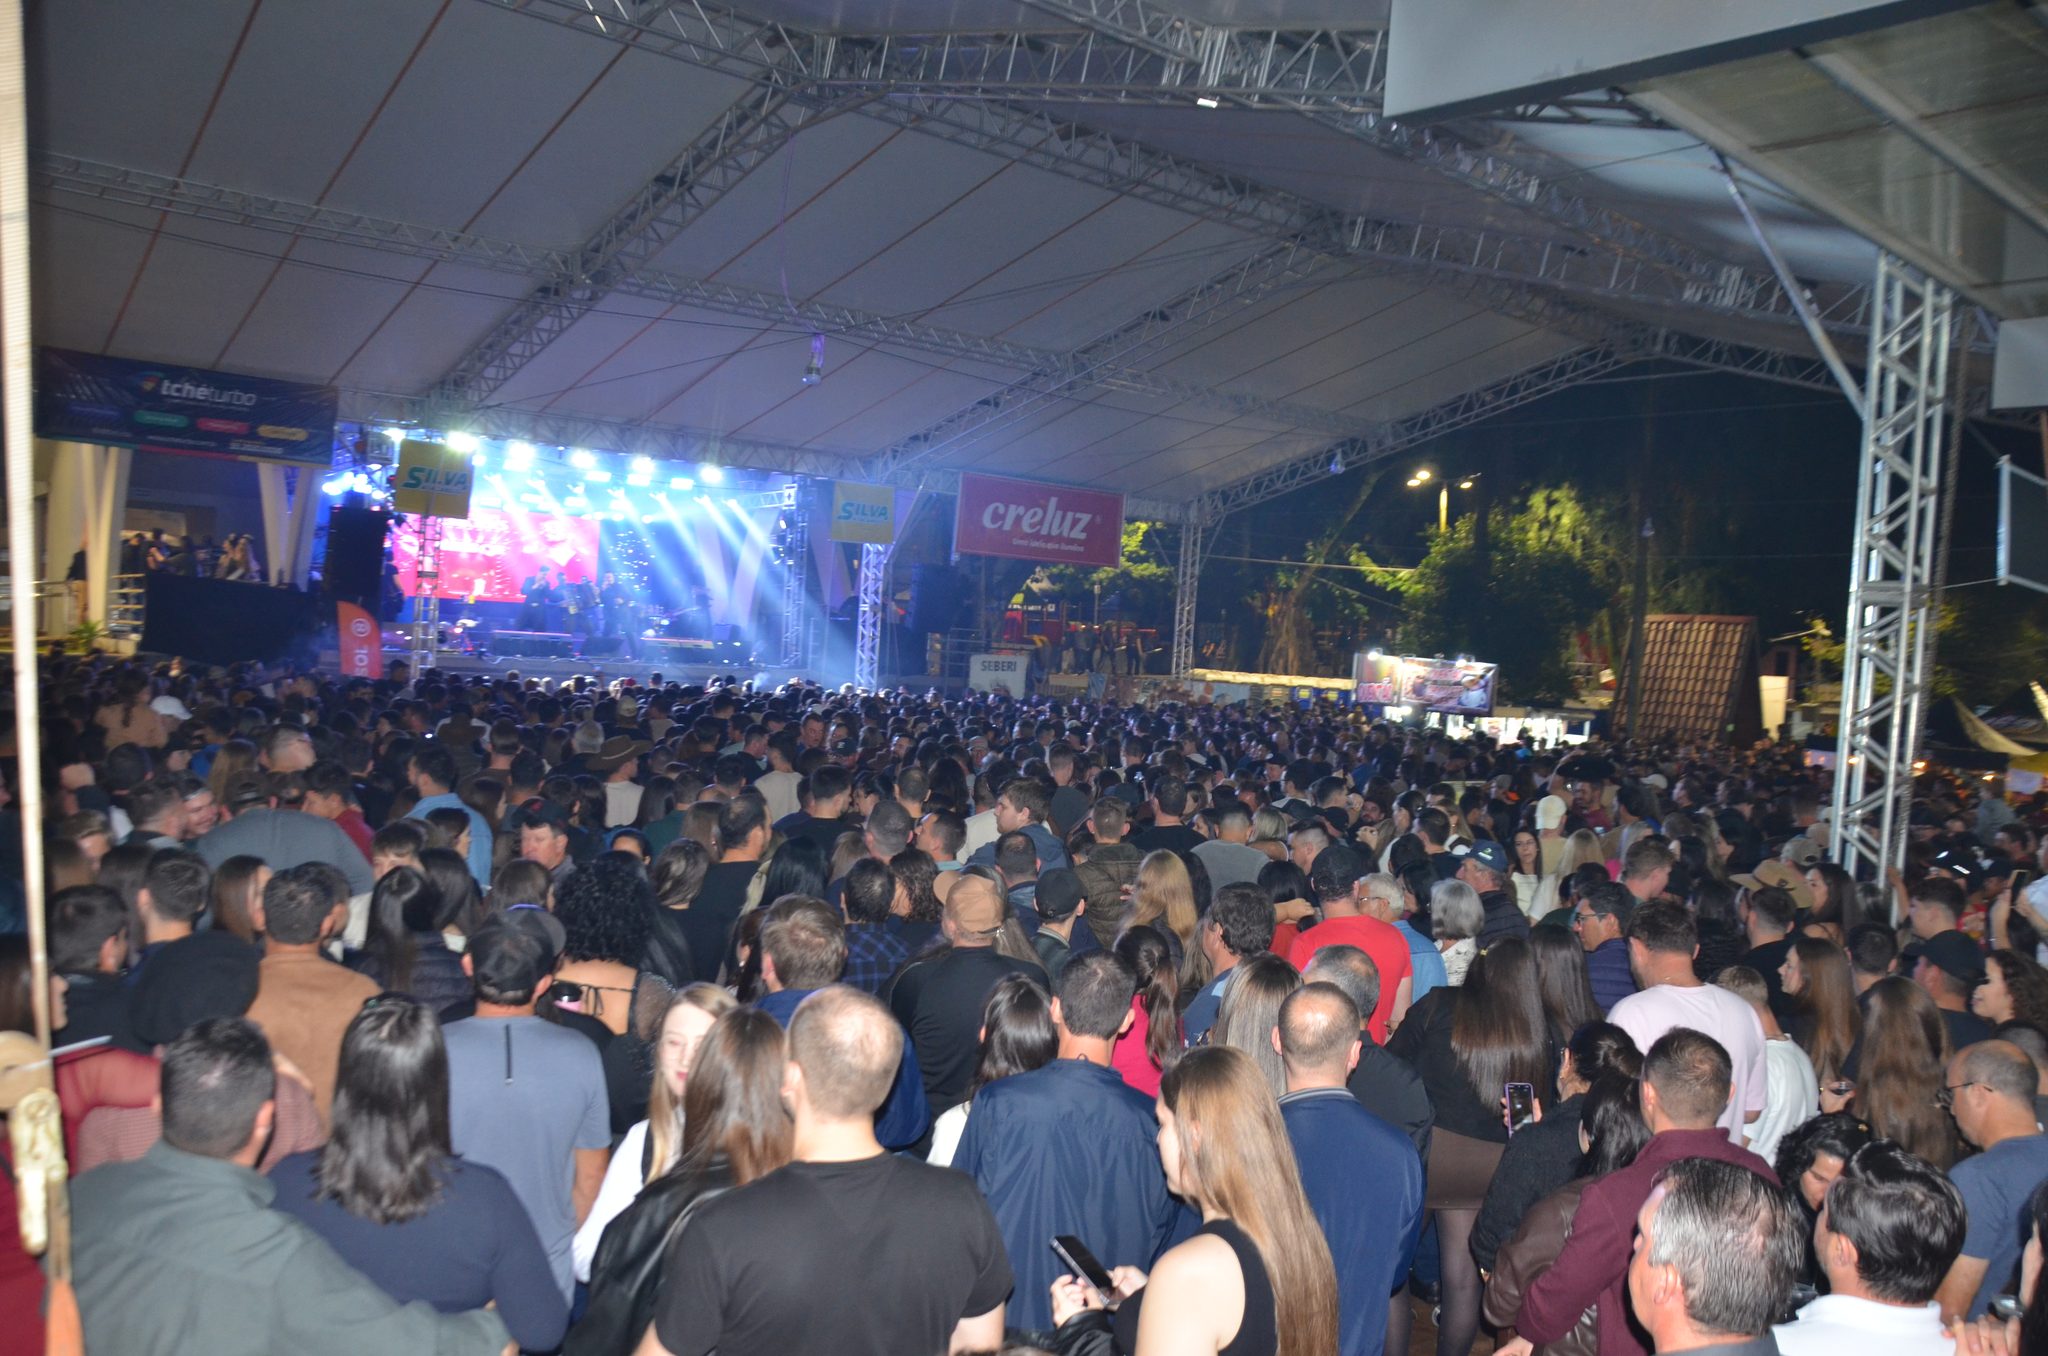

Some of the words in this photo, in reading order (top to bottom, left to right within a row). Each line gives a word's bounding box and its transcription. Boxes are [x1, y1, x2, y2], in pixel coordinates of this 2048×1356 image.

[838, 502, 888, 520] SILVA
[982, 496, 1093, 540] creluz
[981, 660, 1018, 673] SEBERI
